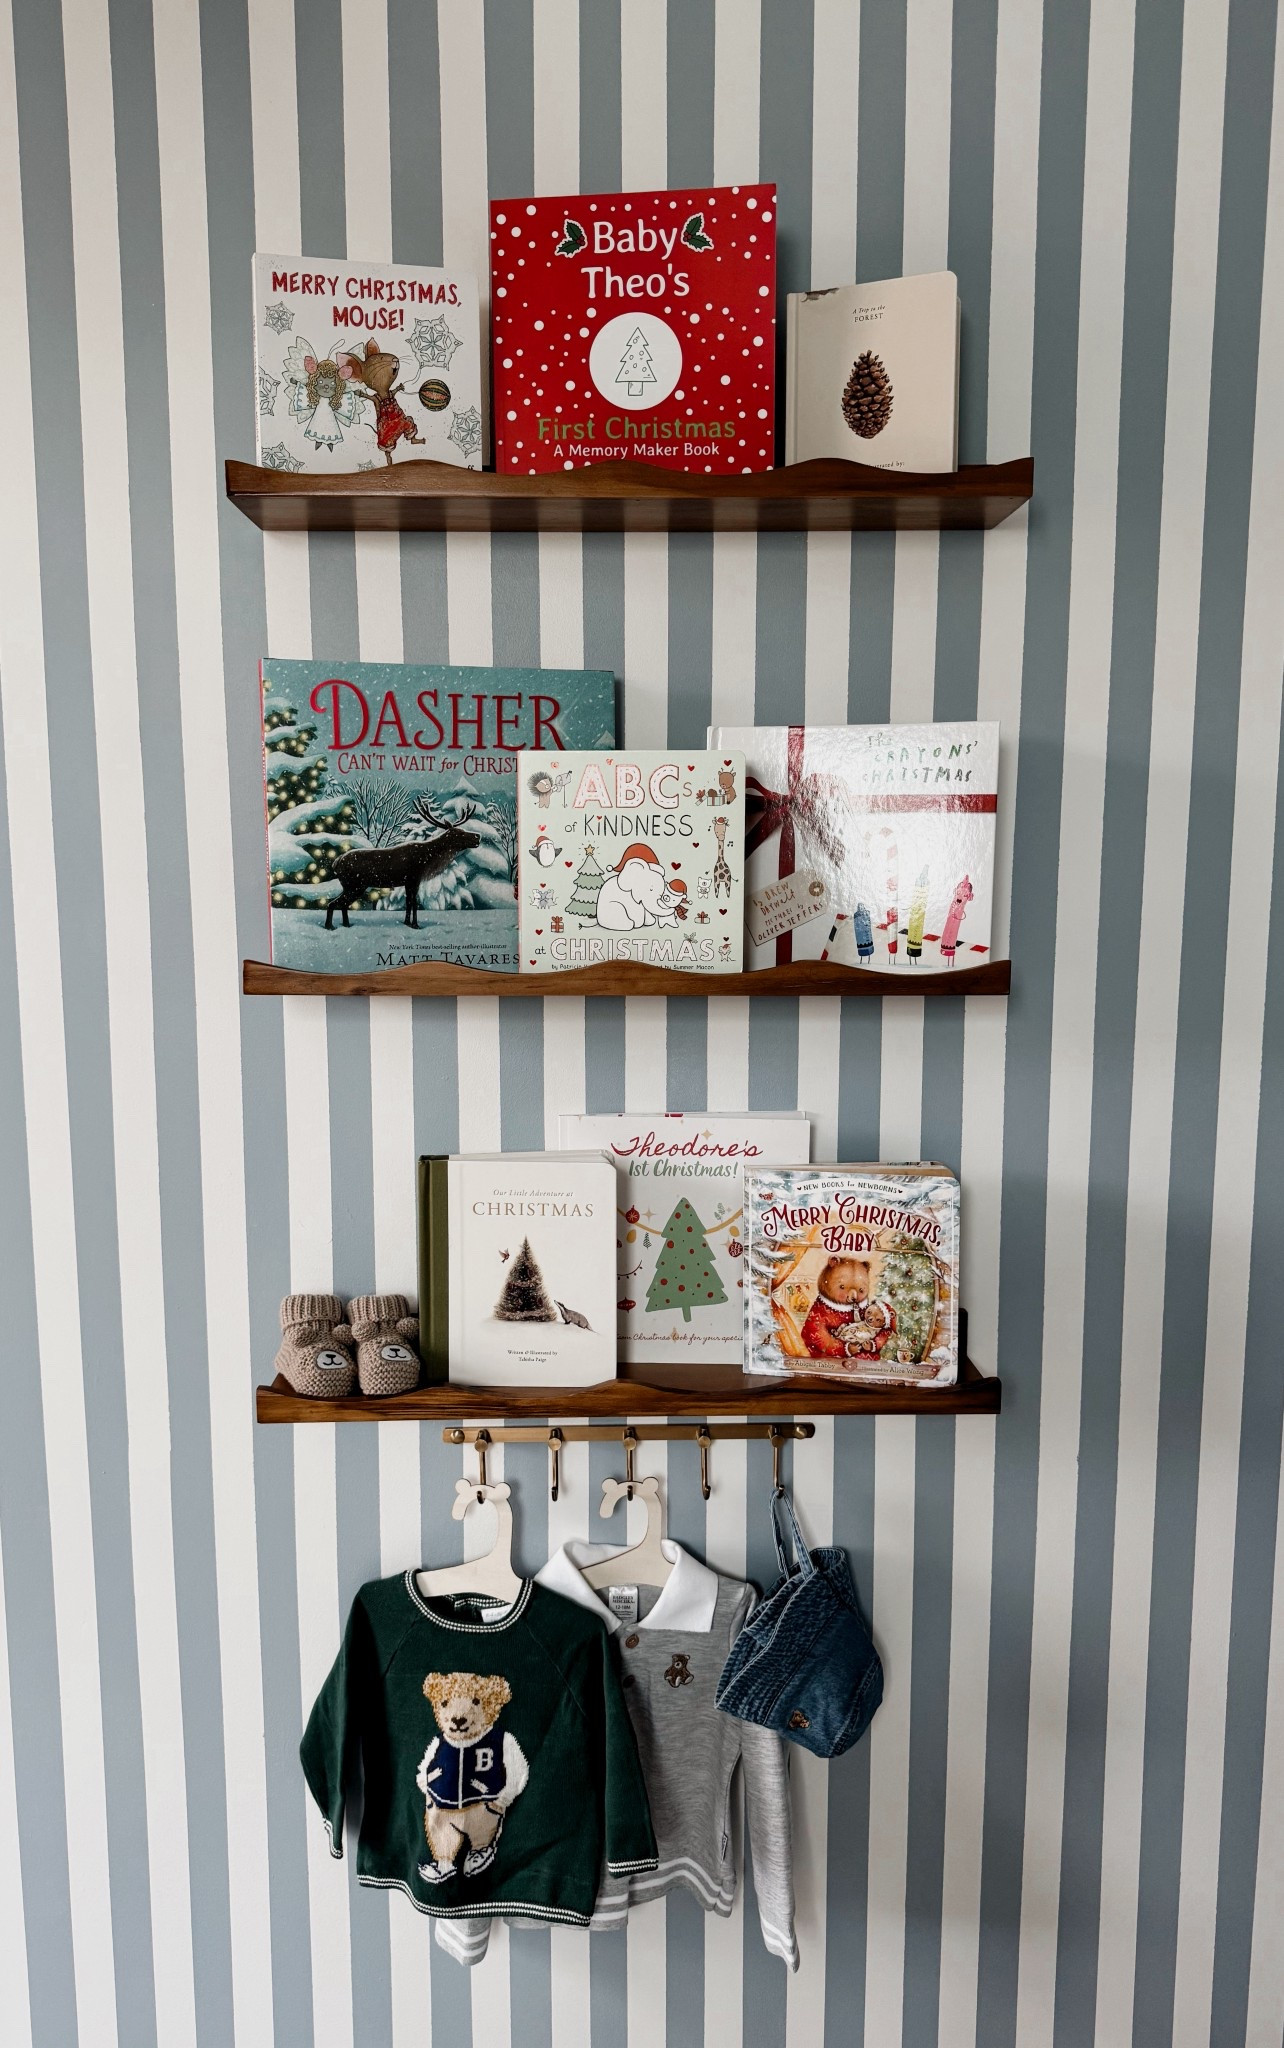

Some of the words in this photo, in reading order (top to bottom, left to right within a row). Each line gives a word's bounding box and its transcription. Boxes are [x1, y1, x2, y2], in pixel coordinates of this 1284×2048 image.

[593, 218, 678, 261] Baby
[271, 271, 339, 296] MERRY
[345, 277, 462, 307] CHRISTMAS,
[580, 263, 690, 298] Theo's
[332, 305, 405, 331] MOUSE!
[854, 312, 884, 323] FOREST
[537, 417, 596, 440] First
[605, 416, 736, 439] Christmas
[553, 444, 564, 457] A
[568, 444, 628, 460] Memory
[633, 443, 679, 456] Maker
[684, 442, 720, 456] Book
[309, 678, 567, 751] DASHER
[337, 752, 386, 774] CAN'T
[392, 756, 436, 773] WAIT
[438, 756, 460, 774] for
[463, 754, 518, 776] CHRIST
[874, 740, 978, 764] CRAYONS'
[572, 763, 693, 809] ABCs
[564, 822, 577, 833] of
[758, 921, 785, 941] OLIVER
[786, 902, 824, 926] JEFFERS
[440, 951, 520, 965] TAVARES
[534, 946, 546, 955] at
[550, 938, 715, 962] CHRISTMAS
[611, 1131, 764, 1157] Theodore's
[653, 1158, 739, 1179] Christmas!
[803, 1183, 818, 1191] NEW
[821, 1180, 844, 1189] BOOKS
[858, 1182, 898, 1194] NEWBORNS
[472, 1201, 594, 1218] CHRISTMAS
[760, 1204, 831, 1238] MERRY
[834, 1192, 942, 1247] CHRISTMAS,
[820, 1225, 875, 1253] BABY
[633, 1332, 671, 1341] Christmas
[688, 1333, 702, 1346] for
[702, 1336, 720, 1345] your
[474, 1747, 494, 1772] B
